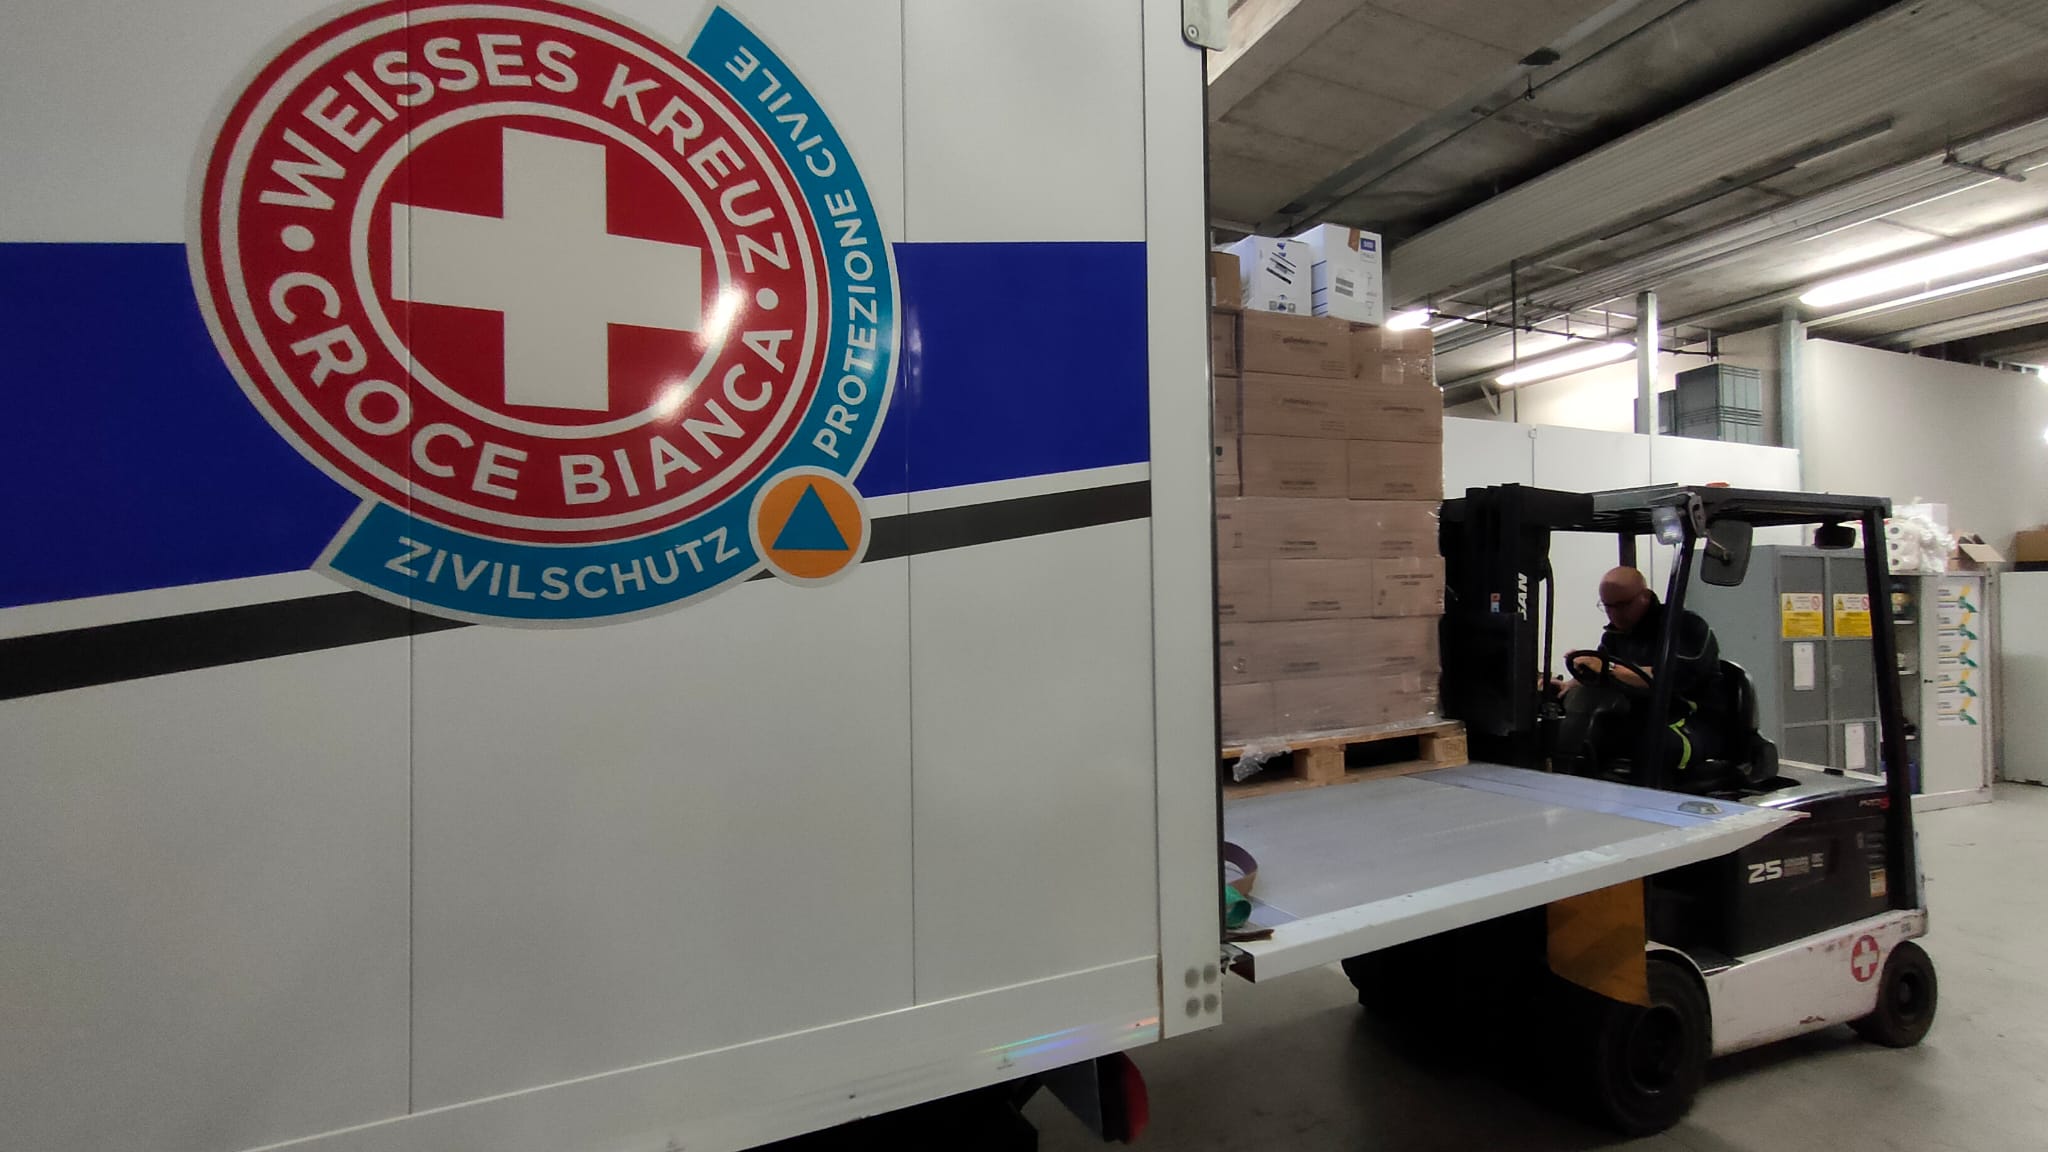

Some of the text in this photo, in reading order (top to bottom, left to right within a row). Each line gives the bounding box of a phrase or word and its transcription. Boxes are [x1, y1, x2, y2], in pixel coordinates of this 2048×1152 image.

[259, 33, 790, 272] WEISSES KREUZ
[724, 45, 878, 459] PROTEZIONE CIVILE
[269, 272, 793, 505] CROCE BIANCA
[385, 526, 739, 600] ZIVILSCHUTZ
[1748, 860, 1783, 884] 25
